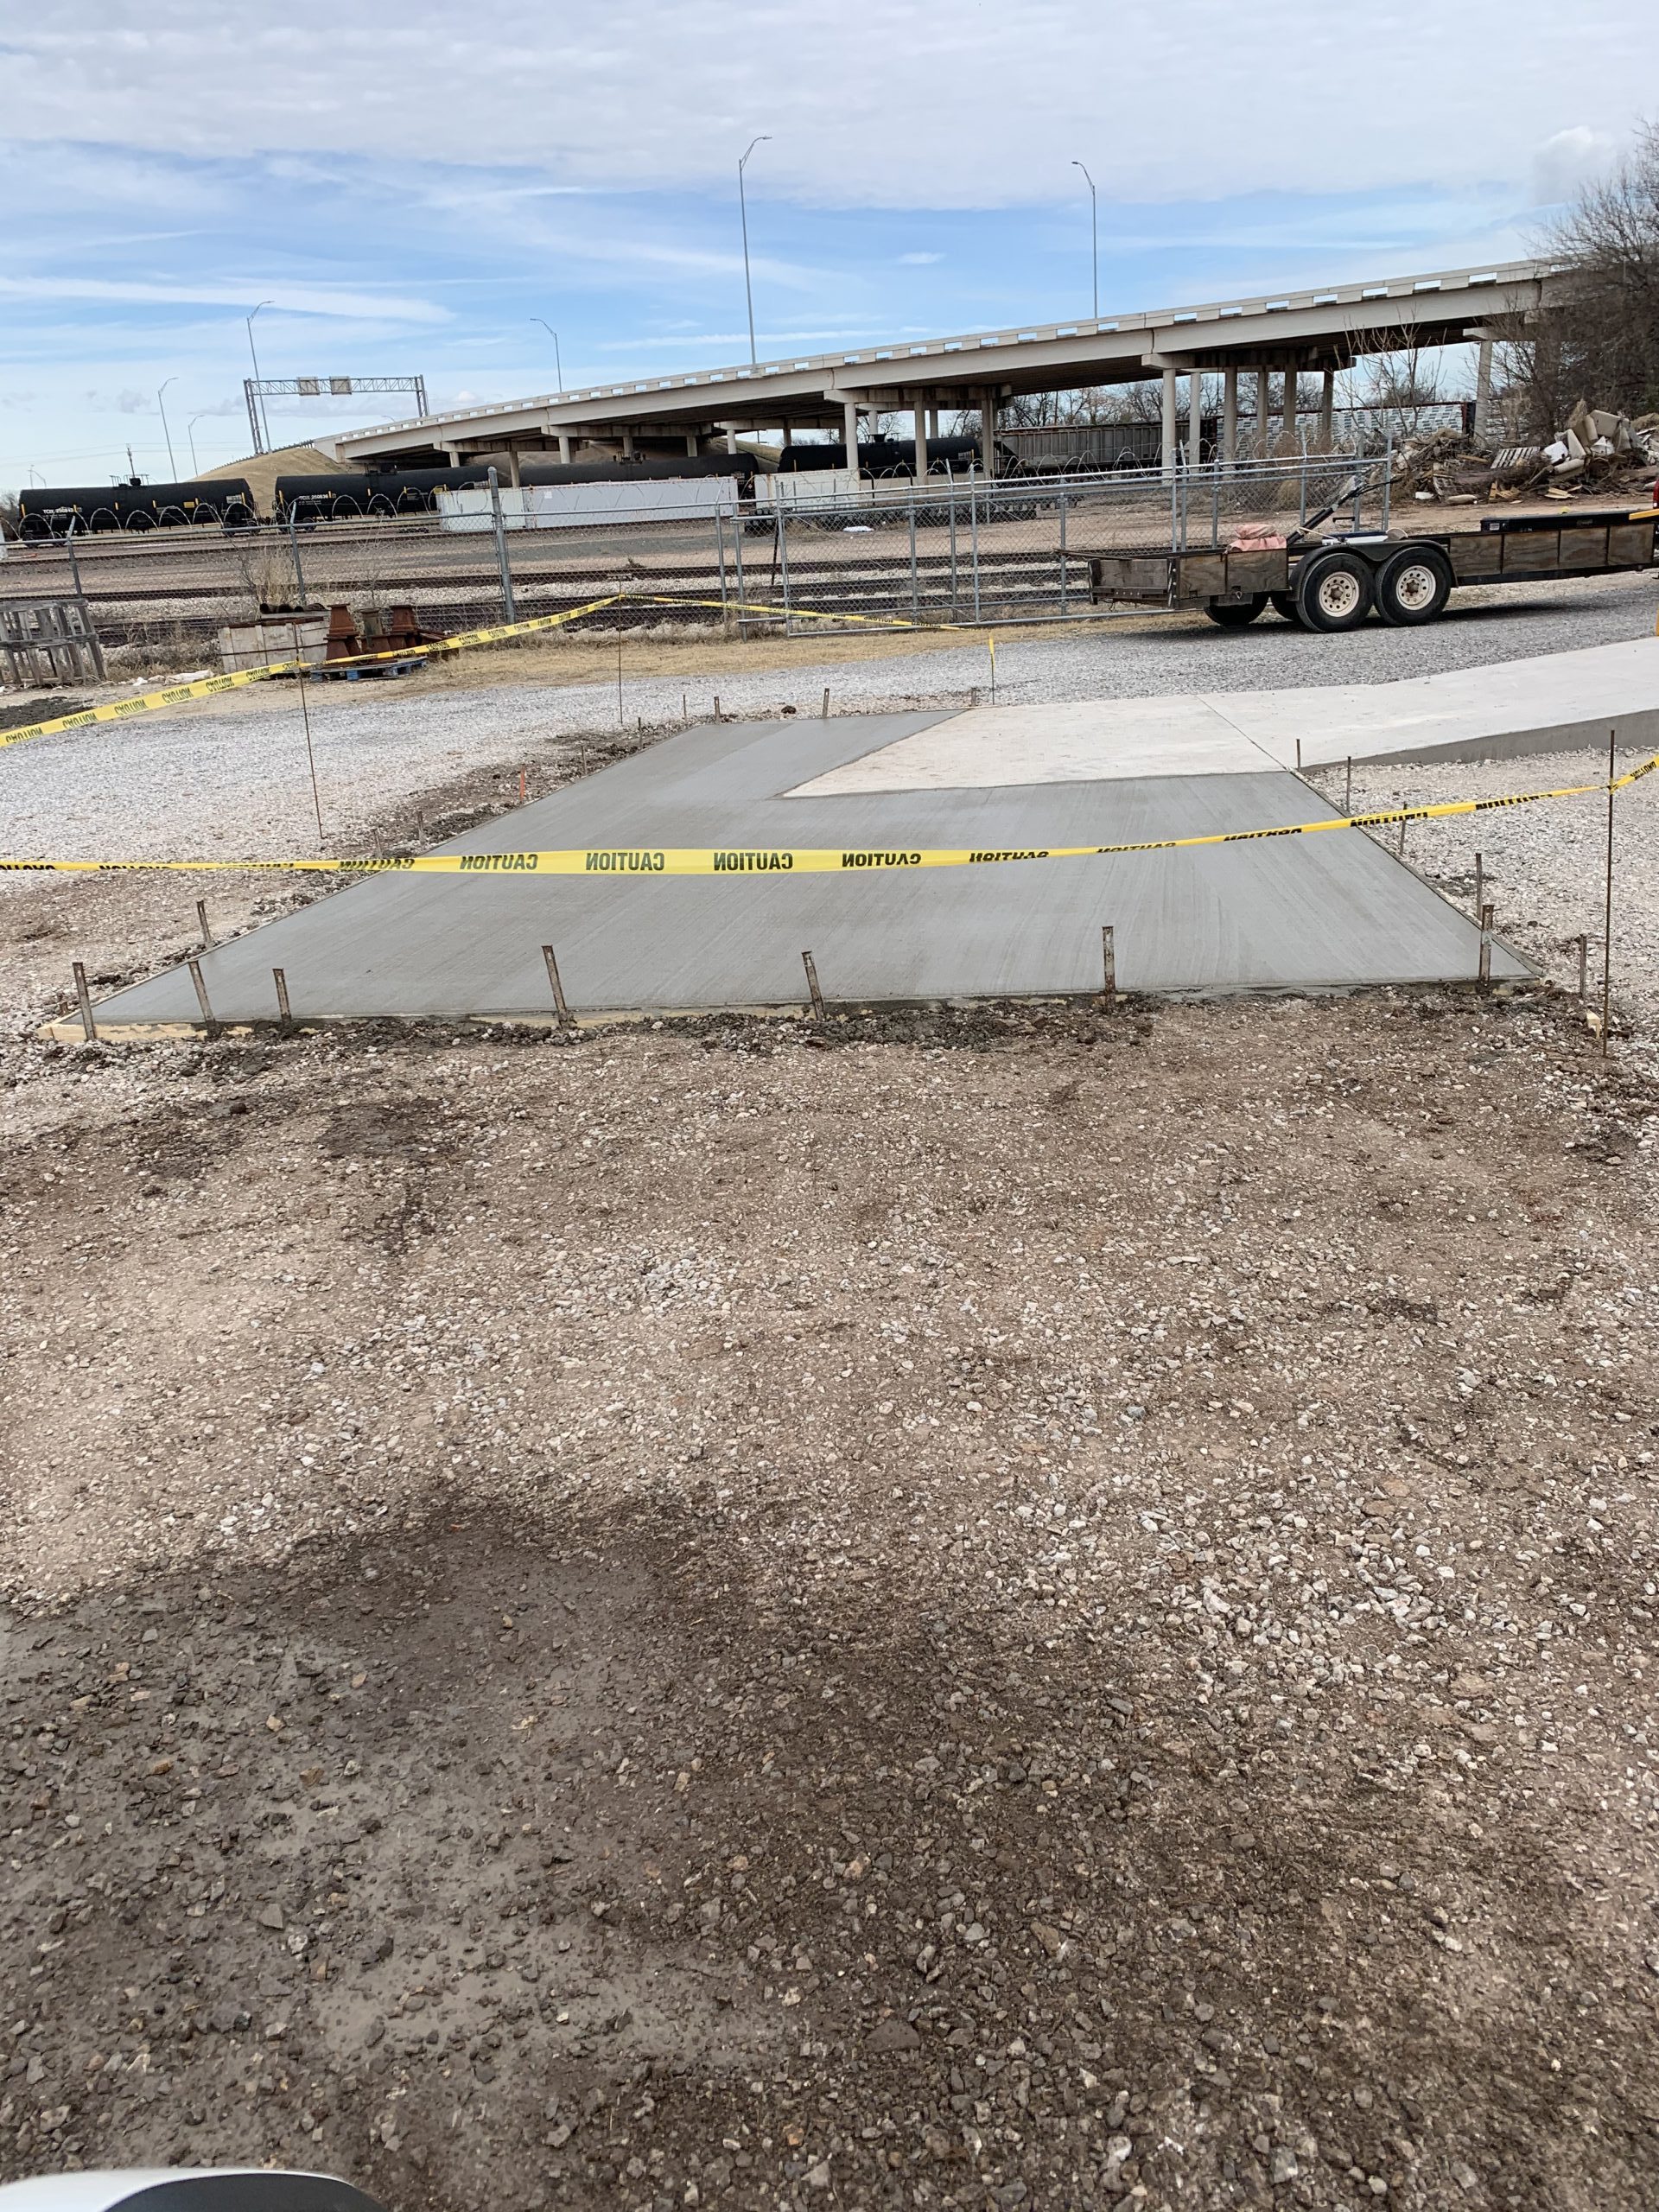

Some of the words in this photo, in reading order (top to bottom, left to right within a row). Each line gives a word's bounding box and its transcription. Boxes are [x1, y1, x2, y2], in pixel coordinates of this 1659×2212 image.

[427, 641, 450, 652] CAUTION
[458, 633, 481, 645] CAUTION
[488, 627, 507, 639] CAUTION
